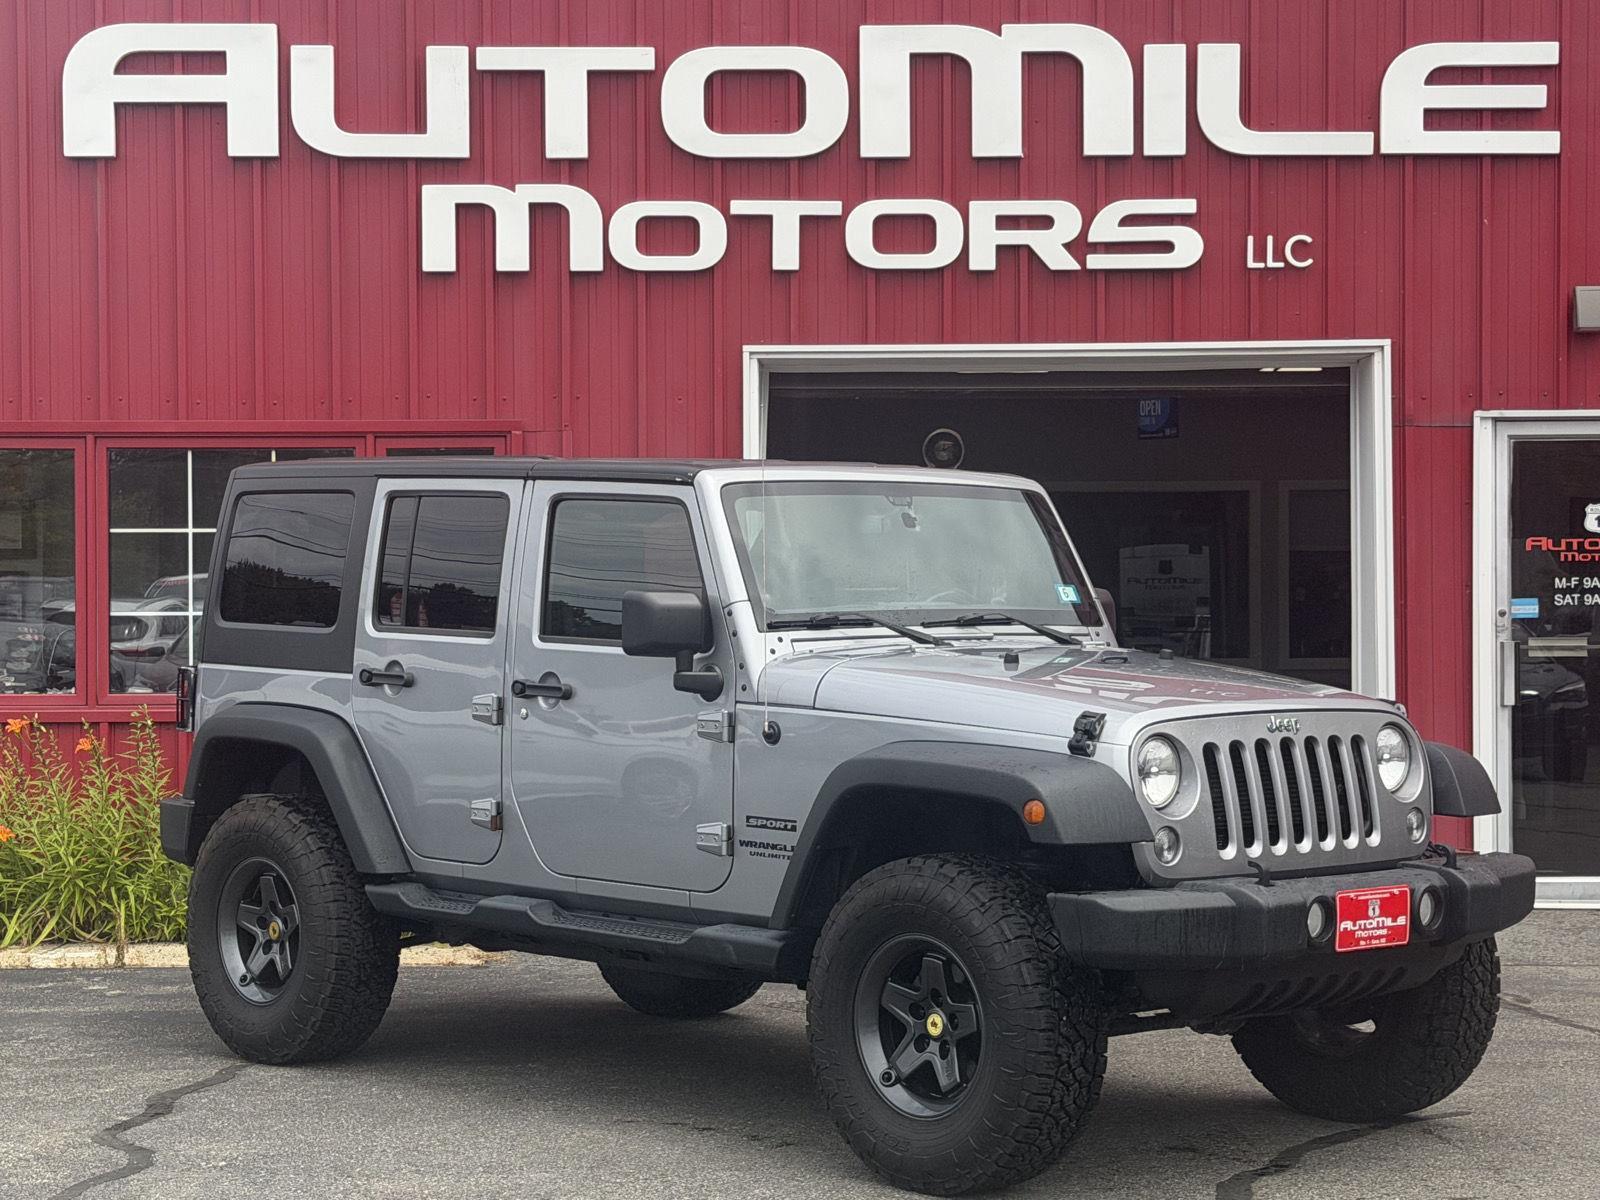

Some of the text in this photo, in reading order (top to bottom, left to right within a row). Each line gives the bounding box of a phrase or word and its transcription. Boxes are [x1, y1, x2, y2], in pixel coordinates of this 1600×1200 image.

[62, 23, 1560, 159] AUTOMILE
[421, 183, 1314, 272] MOTORS LLC
[1139, 399, 1162, 416] OPEN
[1554, 576, 1580, 589] M-F
[1554, 593, 1580, 606] SAT
[1266, 715, 1301, 735] Jeep
[746, 817, 797, 830] SPORT
[1340, 916, 1406, 932] AUTOMILE
[1355, 929, 1388, 938] MOTORS
